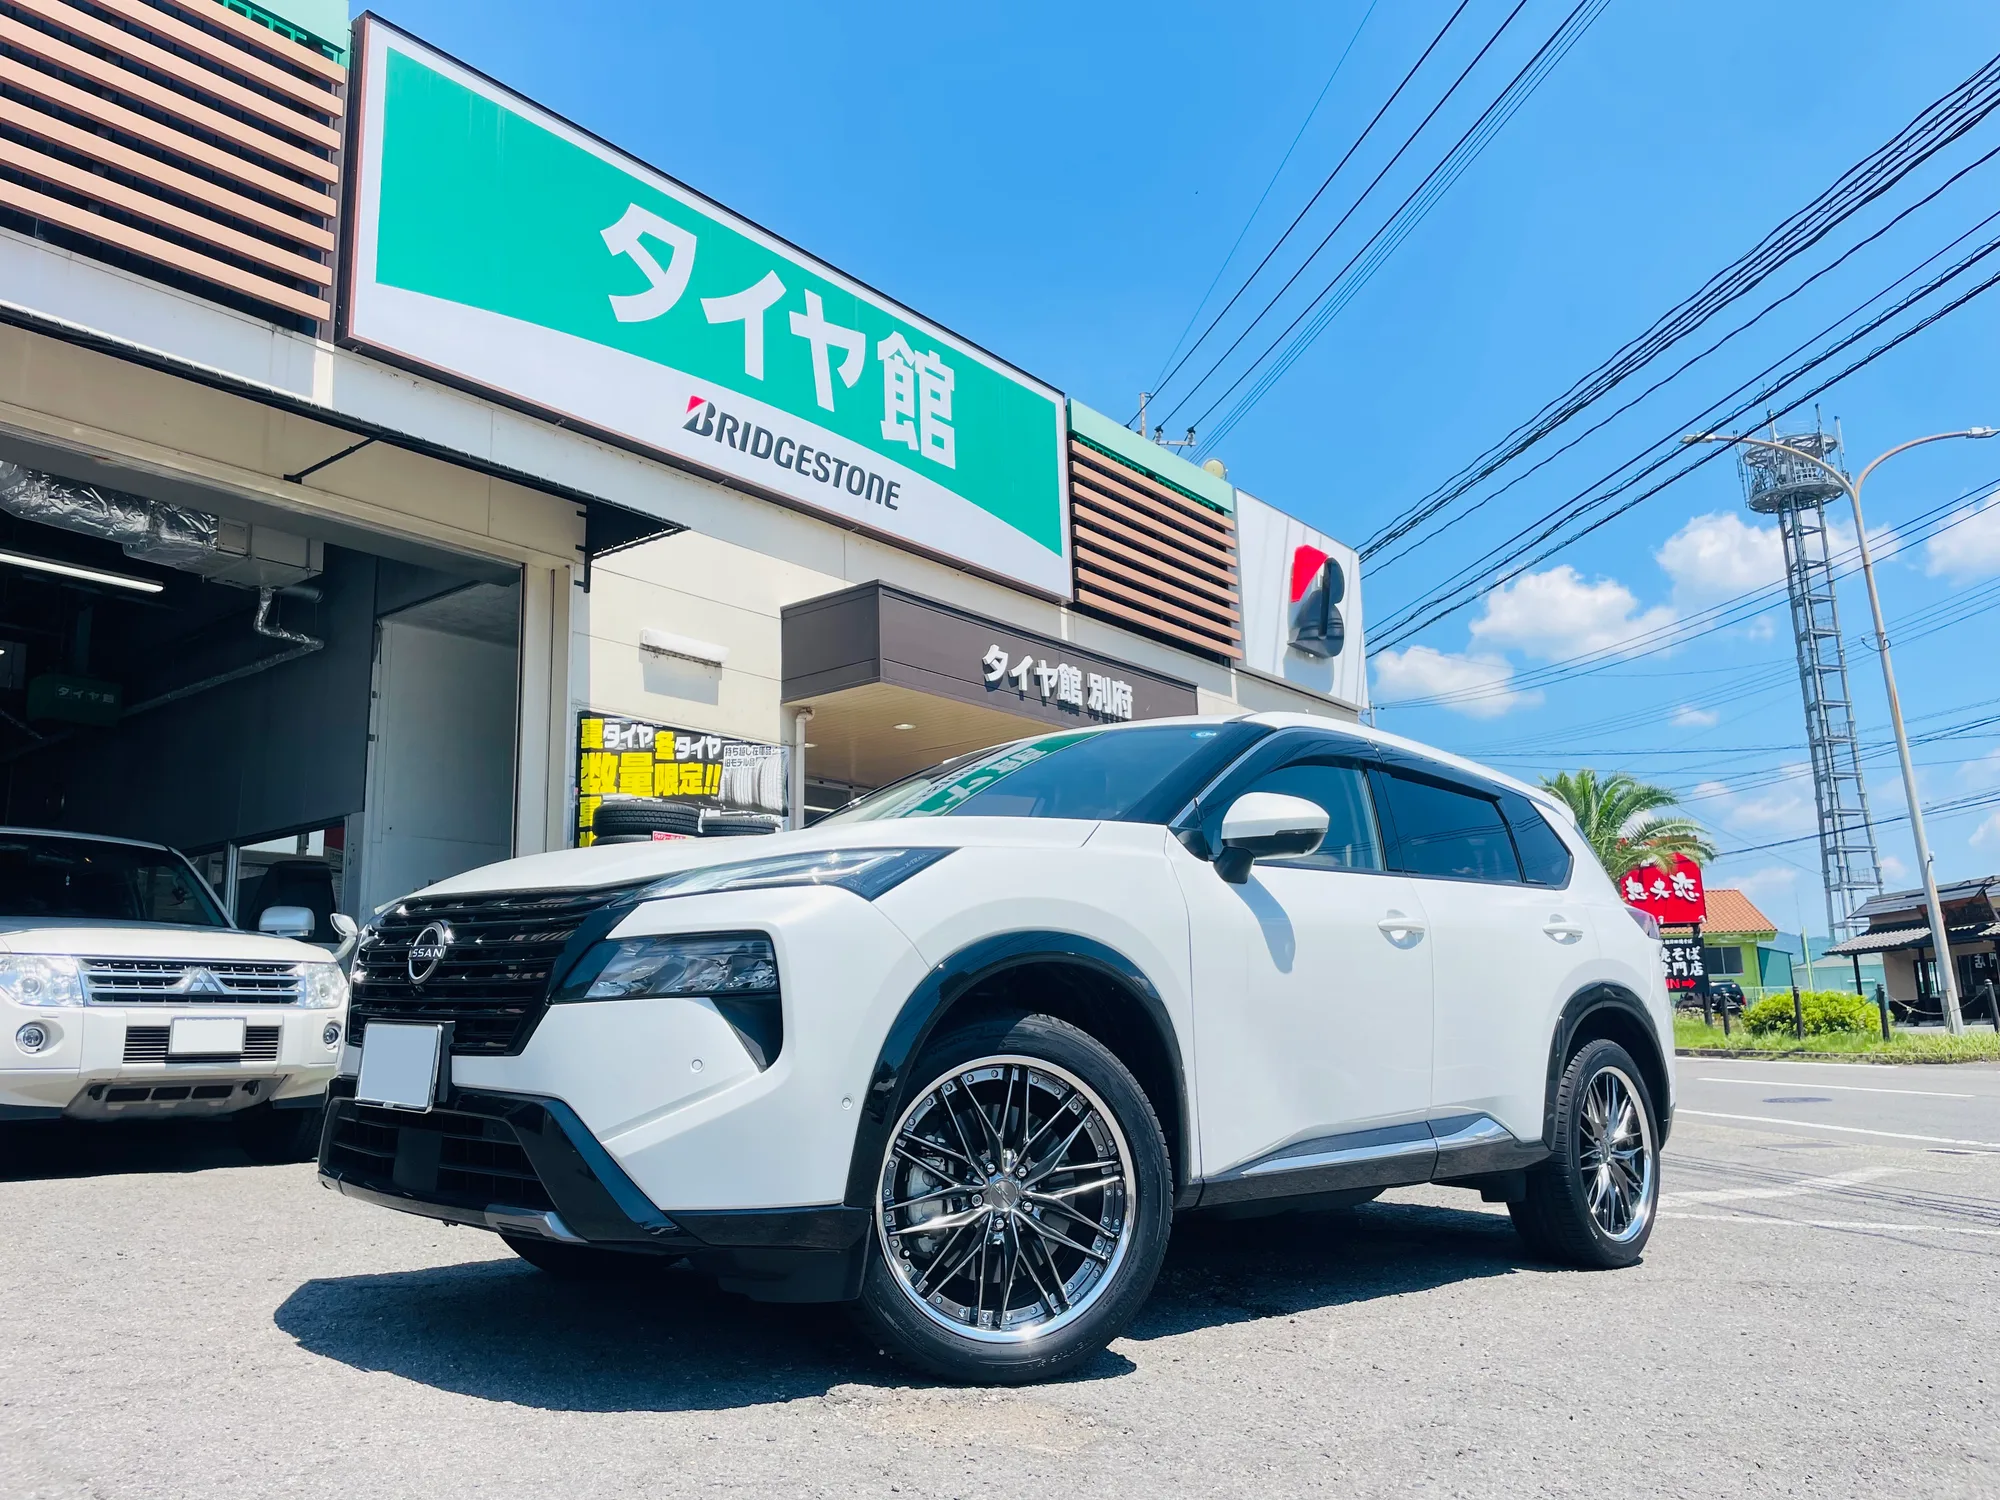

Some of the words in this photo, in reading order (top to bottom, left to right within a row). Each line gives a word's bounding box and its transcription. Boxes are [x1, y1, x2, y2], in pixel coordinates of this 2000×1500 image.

[600, 202, 956, 470] タイヤ館
[682, 395, 901, 511] BRIDGESTONE
[982, 644, 1083, 706] タイヤ館
[1087, 672, 1133, 719] 別府
